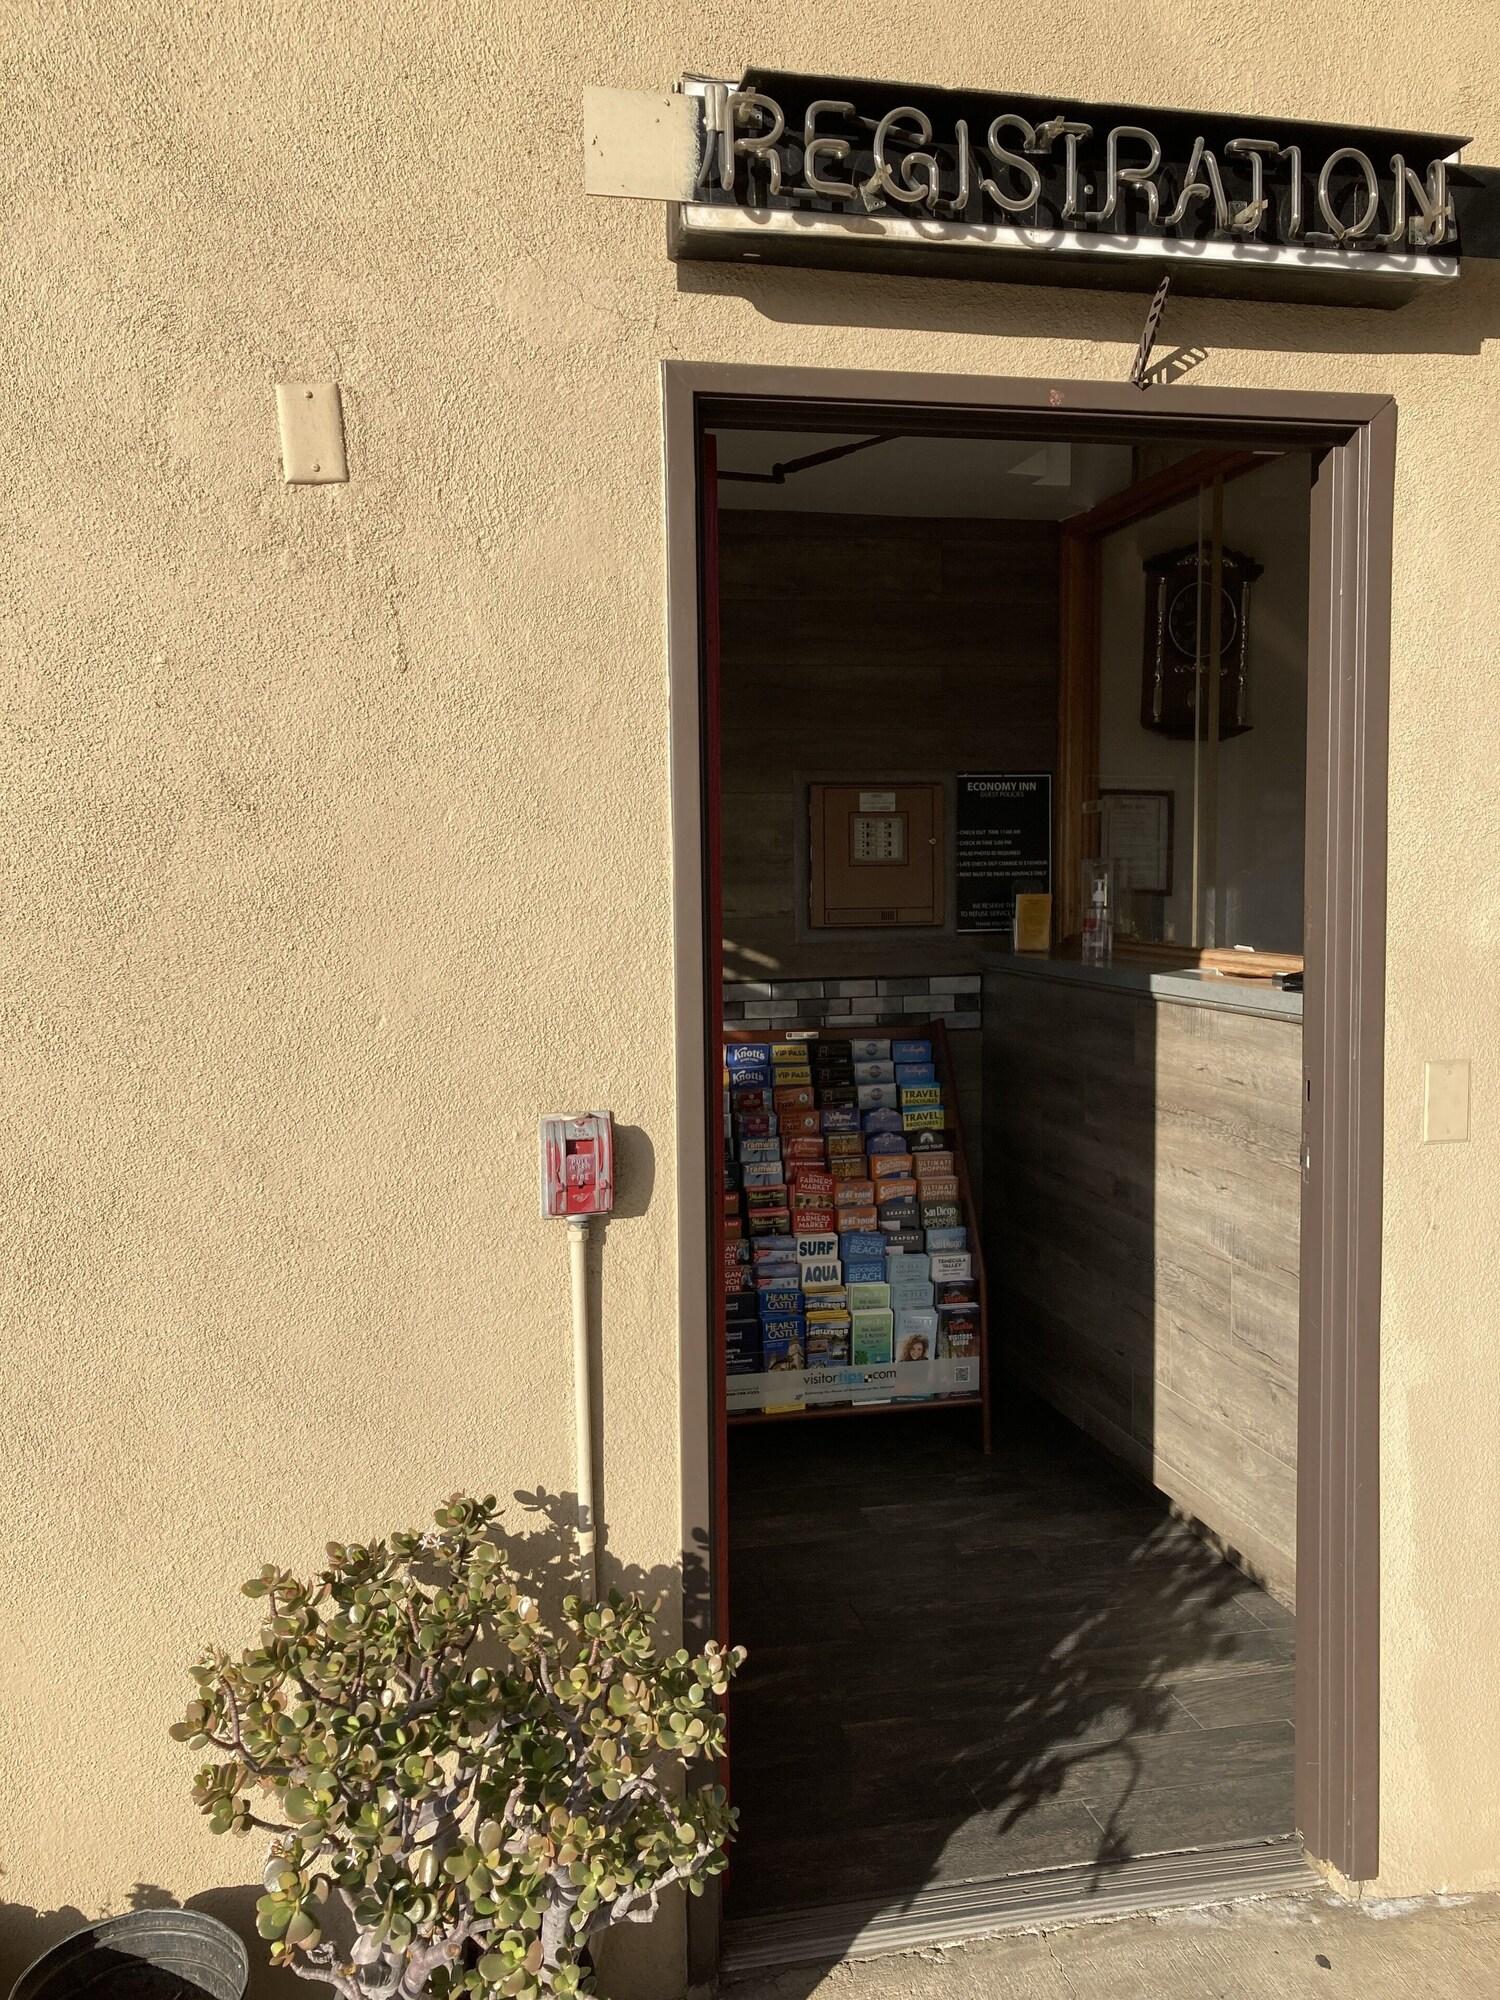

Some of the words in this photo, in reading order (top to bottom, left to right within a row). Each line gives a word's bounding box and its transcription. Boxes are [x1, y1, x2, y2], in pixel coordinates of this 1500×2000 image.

[722, 91, 1449, 246] REGISTRATION
[967, 782, 1018, 792] ECONOMY
[1019, 781, 1037, 791] INN
[734, 1046, 765, 1061] Knott's
[904, 1089, 938, 1099] TRAVEL
[905, 1097, 938, 1105] BROCHURES
[905, 1112, 939, 1121] TRAVEL
[800, 1176, 833, 1185] FARMERS
[800, 1183, 831, 1191] MARKET
[924, 1207, 936, 1218] San
[936, 1206, 957, 1216] Diego
[797, 1215, 831, 1223] FARMERS
[798, 1221, 828, 1229] MARKET
[799, 1241, 834, 1256] SURF
[850, 1245, 882, 1256] BEACH
[805, 1265, 838, 1283] AQUA
[849, 1271, 882, 1282] BEACH
[766, 1292, 799, 1303] HEARST
[767, 1301, 798, 1310] CASTLE
[765, 1320, 800, 1331] HEARST
[767, 1329, 799, 1340] CASTLE
